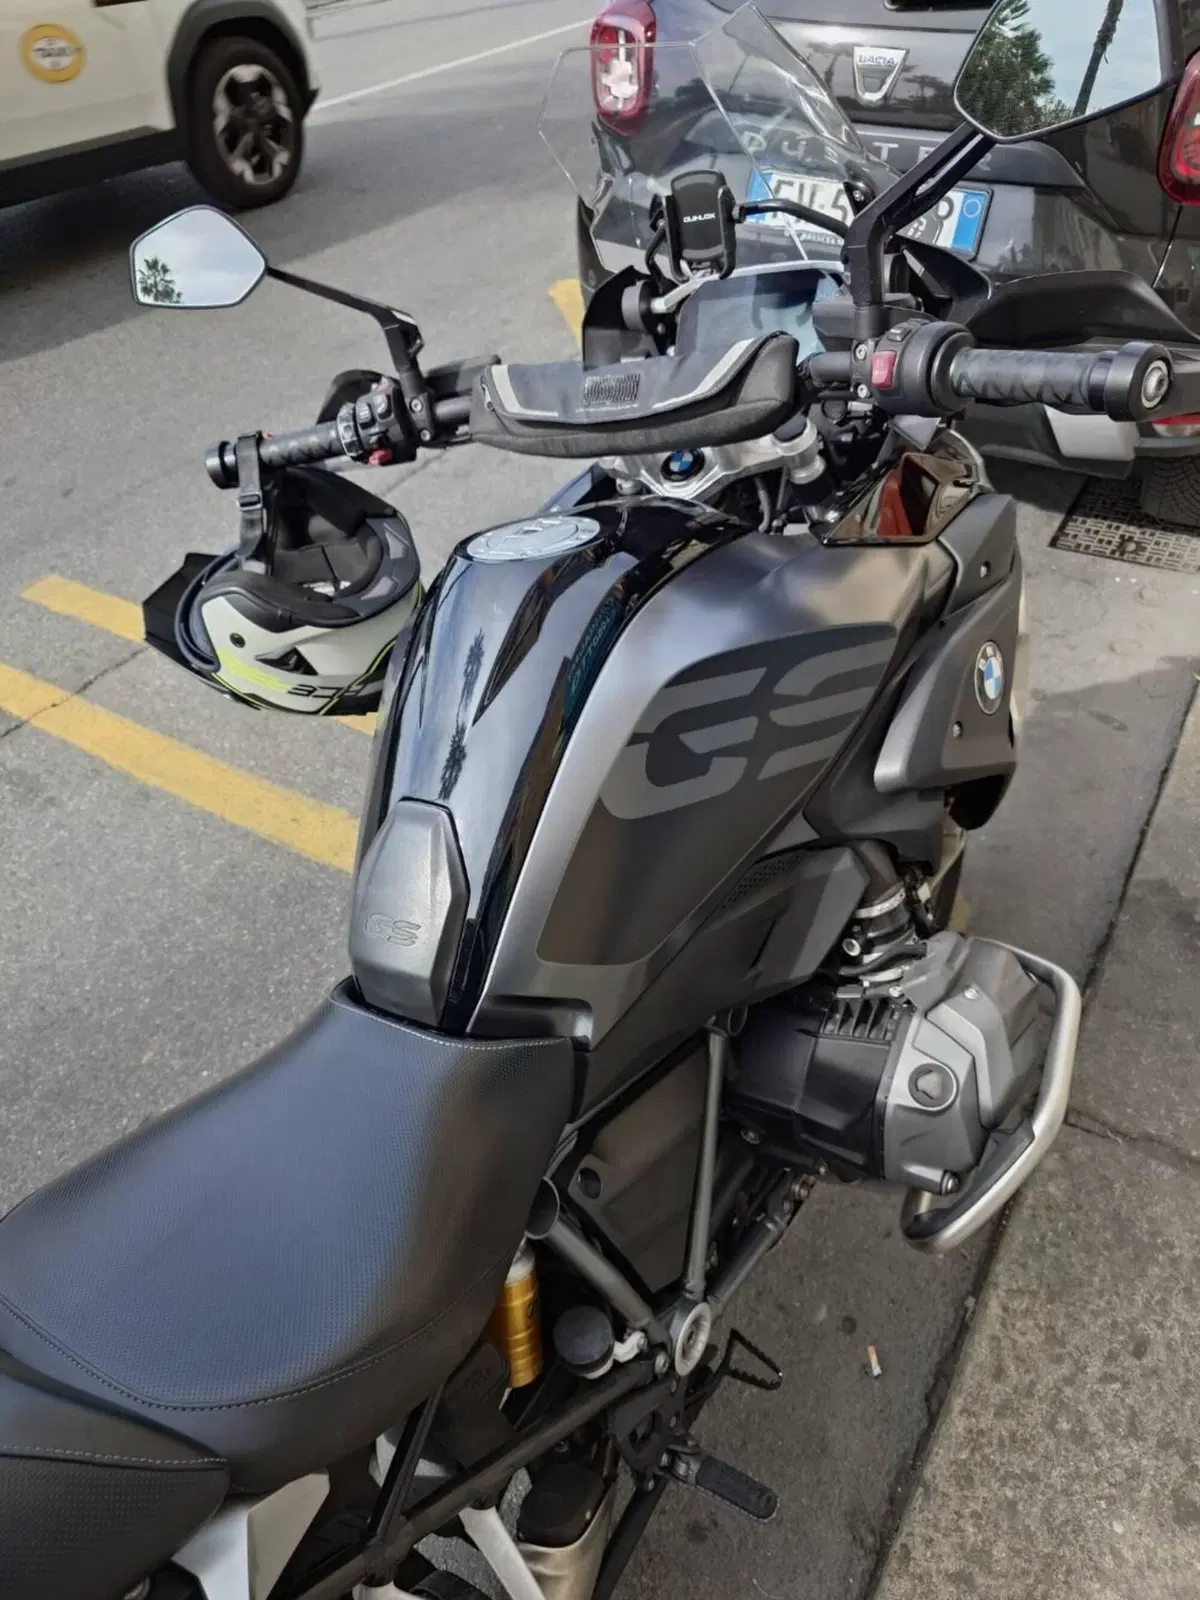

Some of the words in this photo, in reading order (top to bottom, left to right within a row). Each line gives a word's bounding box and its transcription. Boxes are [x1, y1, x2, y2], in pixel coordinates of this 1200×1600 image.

[858, 54, 895, 67] DACIA
[600, 637, 898, 820] GS
[364, 912, 422, 947] GS
